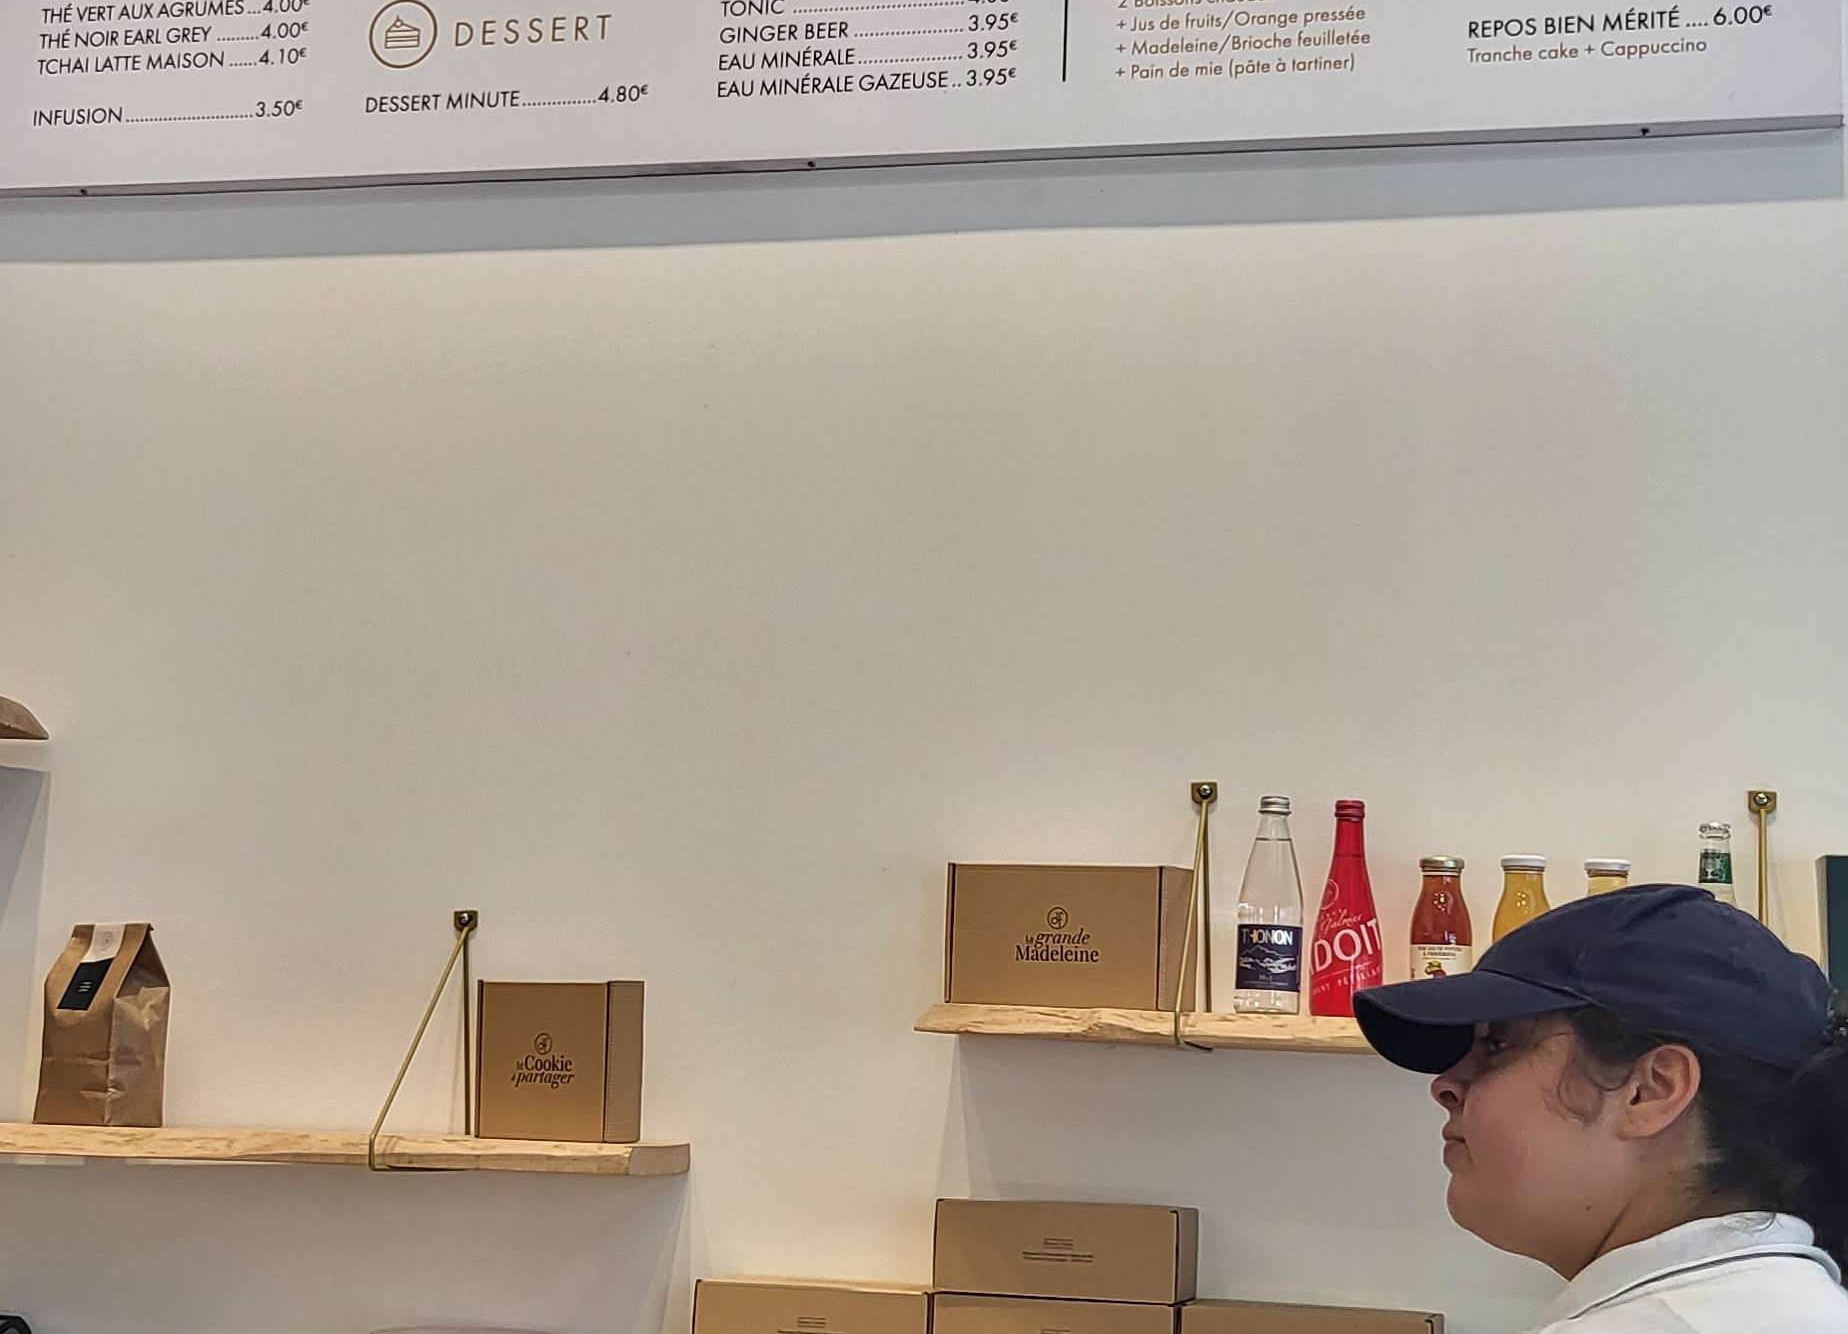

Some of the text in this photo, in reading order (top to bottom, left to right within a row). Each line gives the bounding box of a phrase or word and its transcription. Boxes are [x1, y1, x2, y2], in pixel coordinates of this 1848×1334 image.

[40, 1, 74, 25] THÉ
[75, 4, 117, 24] VERT
[116, 2, 155, 22] AUX
[1468, 4, 1773, 39] REPOS BIEN MÉRITÉ 6.00€
[38, 20, 309, 50] THÉ NOIR EARL GREY 4.00€
[454, 14, 613, 48] DESSERT
[719, 11, 1019, 45] GINGER BEER 3.95€
[1131, 31, 1293, 56] Madeleine/Brioche
[1297, 28, 1371, 48] feuilletée
[36, 47, 308, 76] TCHAI LATTE MAISON 4.10€
[718, 39, 1018, 72] EAU MINÉRALE 3.95€
[1466, 43, 1533, 63] Tranche
[1537, 40, 1579, 60] cake
[1600, 37, 1708, 60] Cappuccino
[717, 66, 1017, 98] EAU MINÉRALE GAZEUSE 3.95€
[33, 99, 304, 127] INFUSION 3.50€
[365, 84, 649, 114] DESSERT MINUTE 4.80€
[1034, 927, 1091, 949] grande
[1242, 929, 1294, 946] THONON
[1310, 918, 1381, 976] DOIT
[1015, 944, 1099, 963] Madeleine
[524, 1054, 573, 1072] Cookie
[515, 1071, 575, 1089] partager
